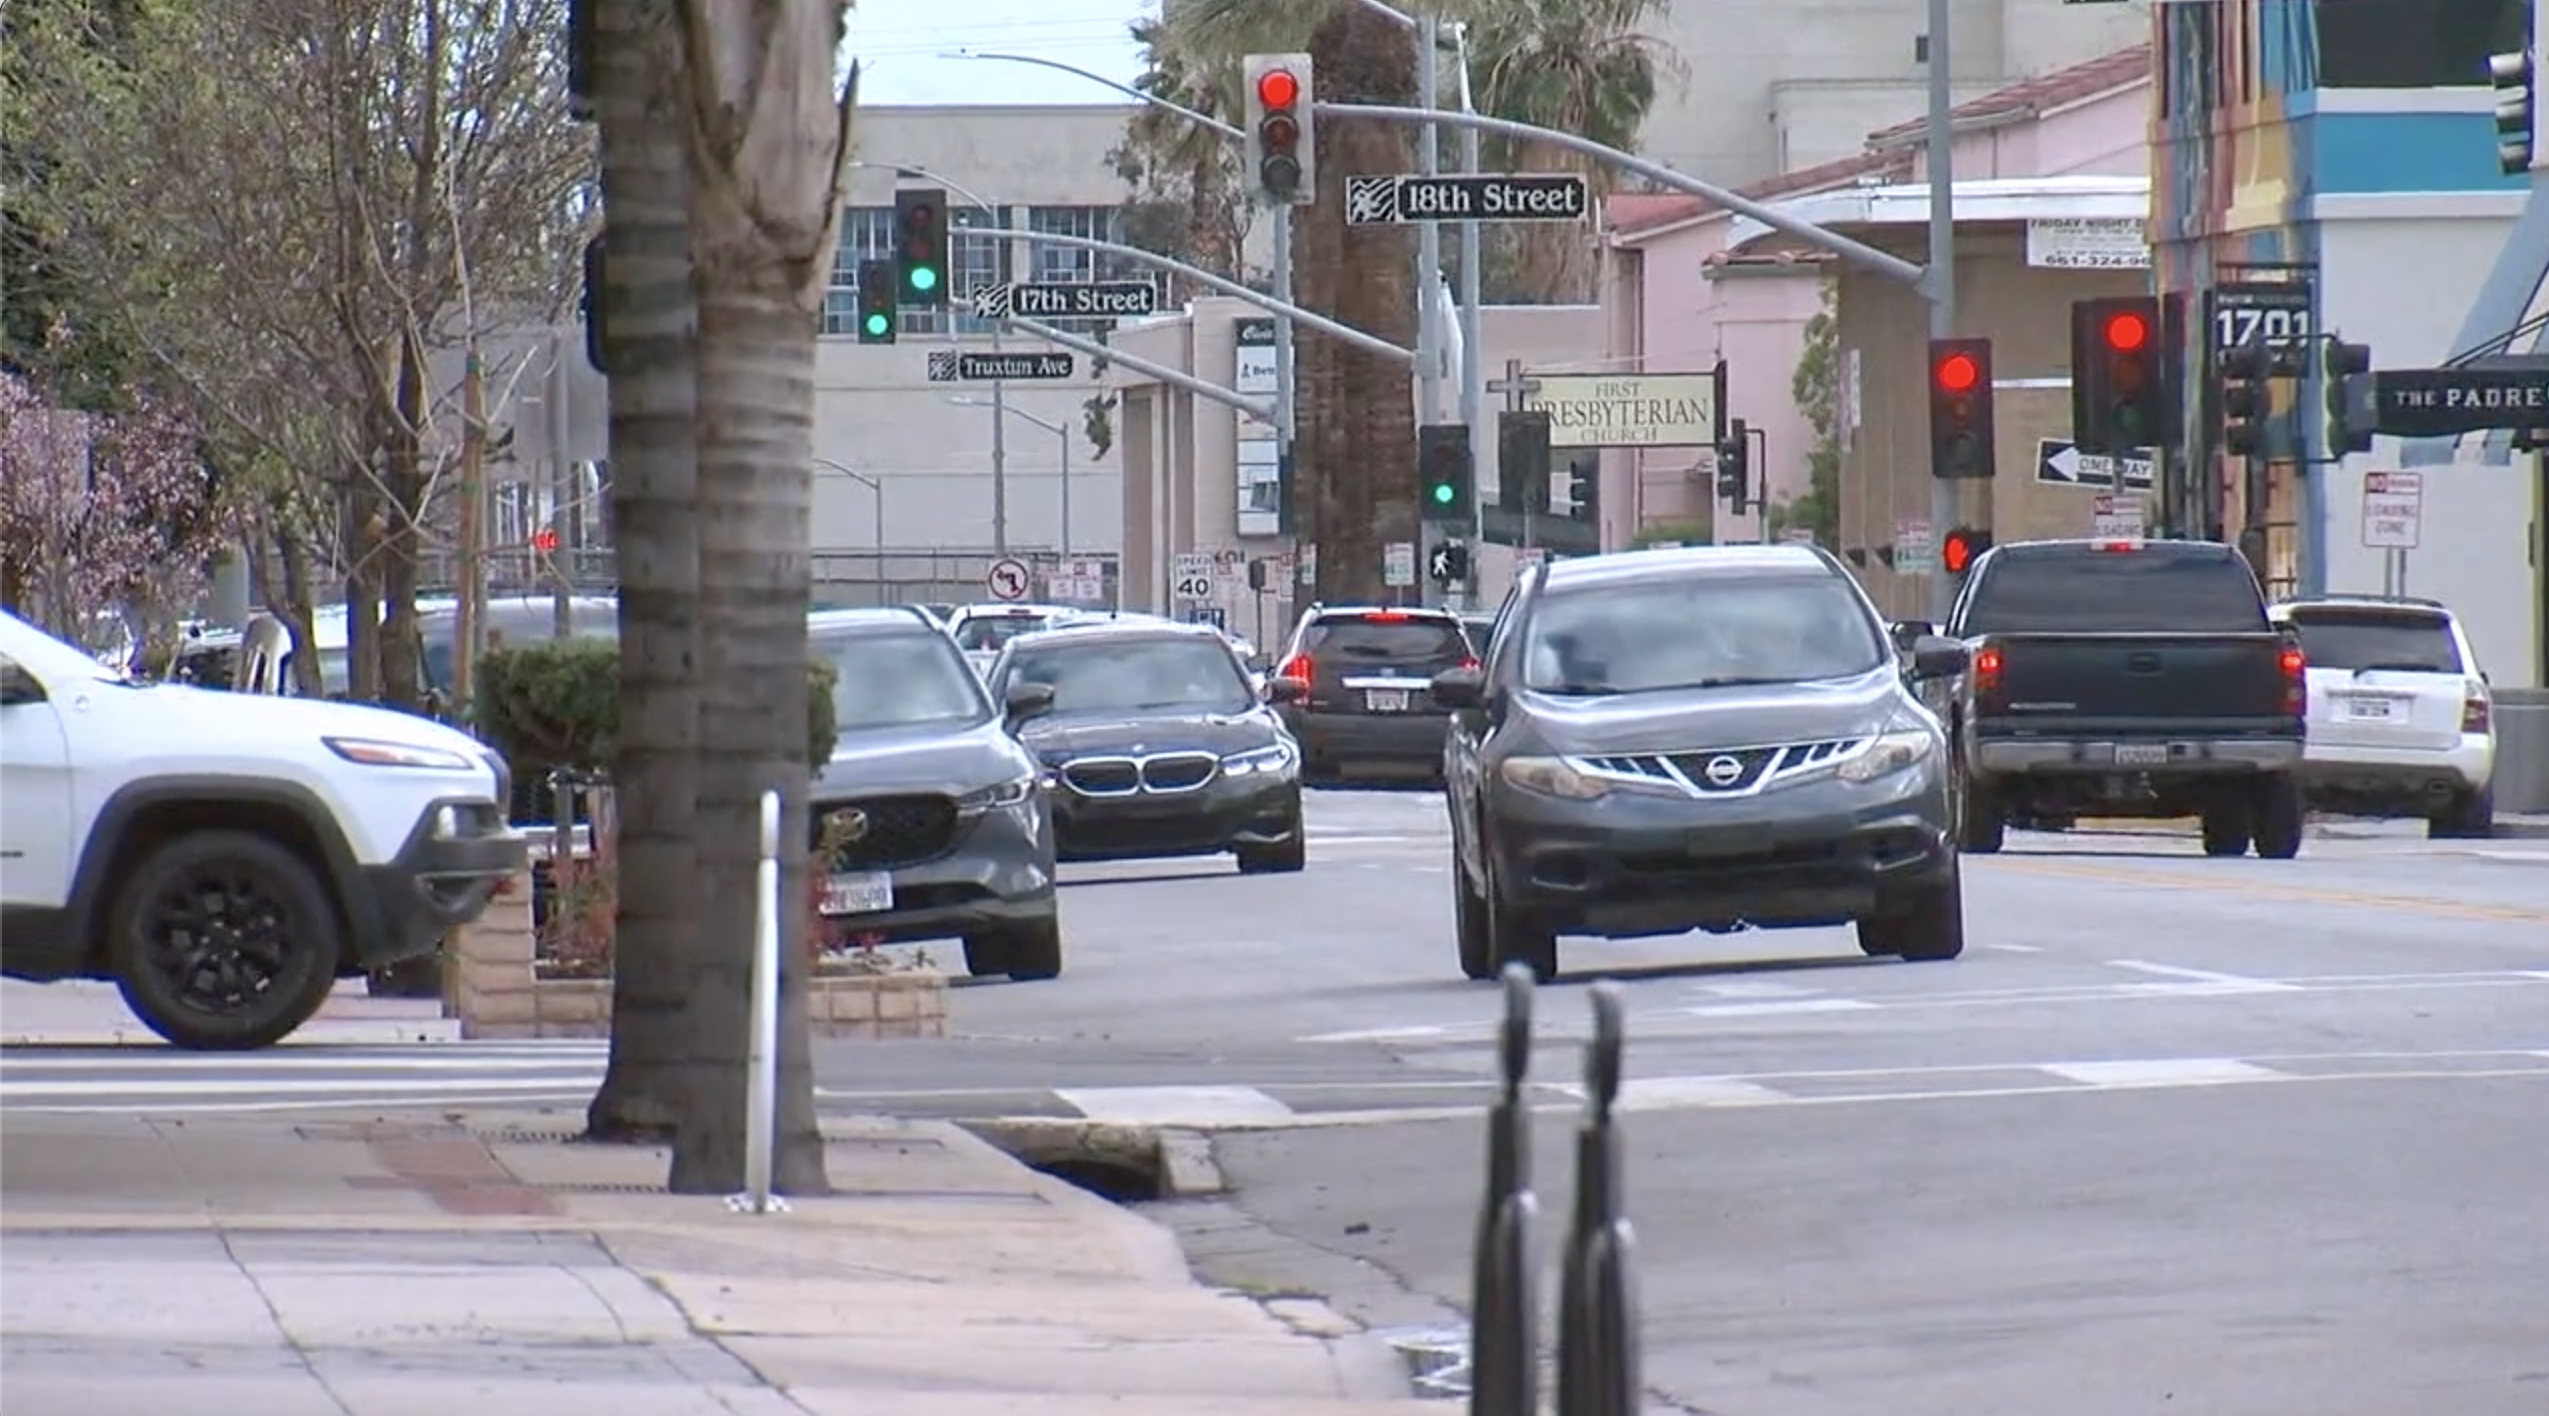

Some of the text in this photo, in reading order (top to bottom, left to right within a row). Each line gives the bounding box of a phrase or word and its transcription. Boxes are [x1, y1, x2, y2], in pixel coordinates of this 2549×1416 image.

[1408, 183, 1578, 213] 18th Street
[1020, 288, 1149, 311] 17th Street
[2217, 309, 2308, 347] 1701
[964, 358, 1069, 376] Truxtun Ave
[1595, 381, 1643, 398] FIRST
[2396, 388, 2543, 408] THE PADRE
[1580, 427, 1658, 442] CHURCH
[2080, 456, 2151, 476] ONE AY
[1177, 578, 1210, 596] 40
